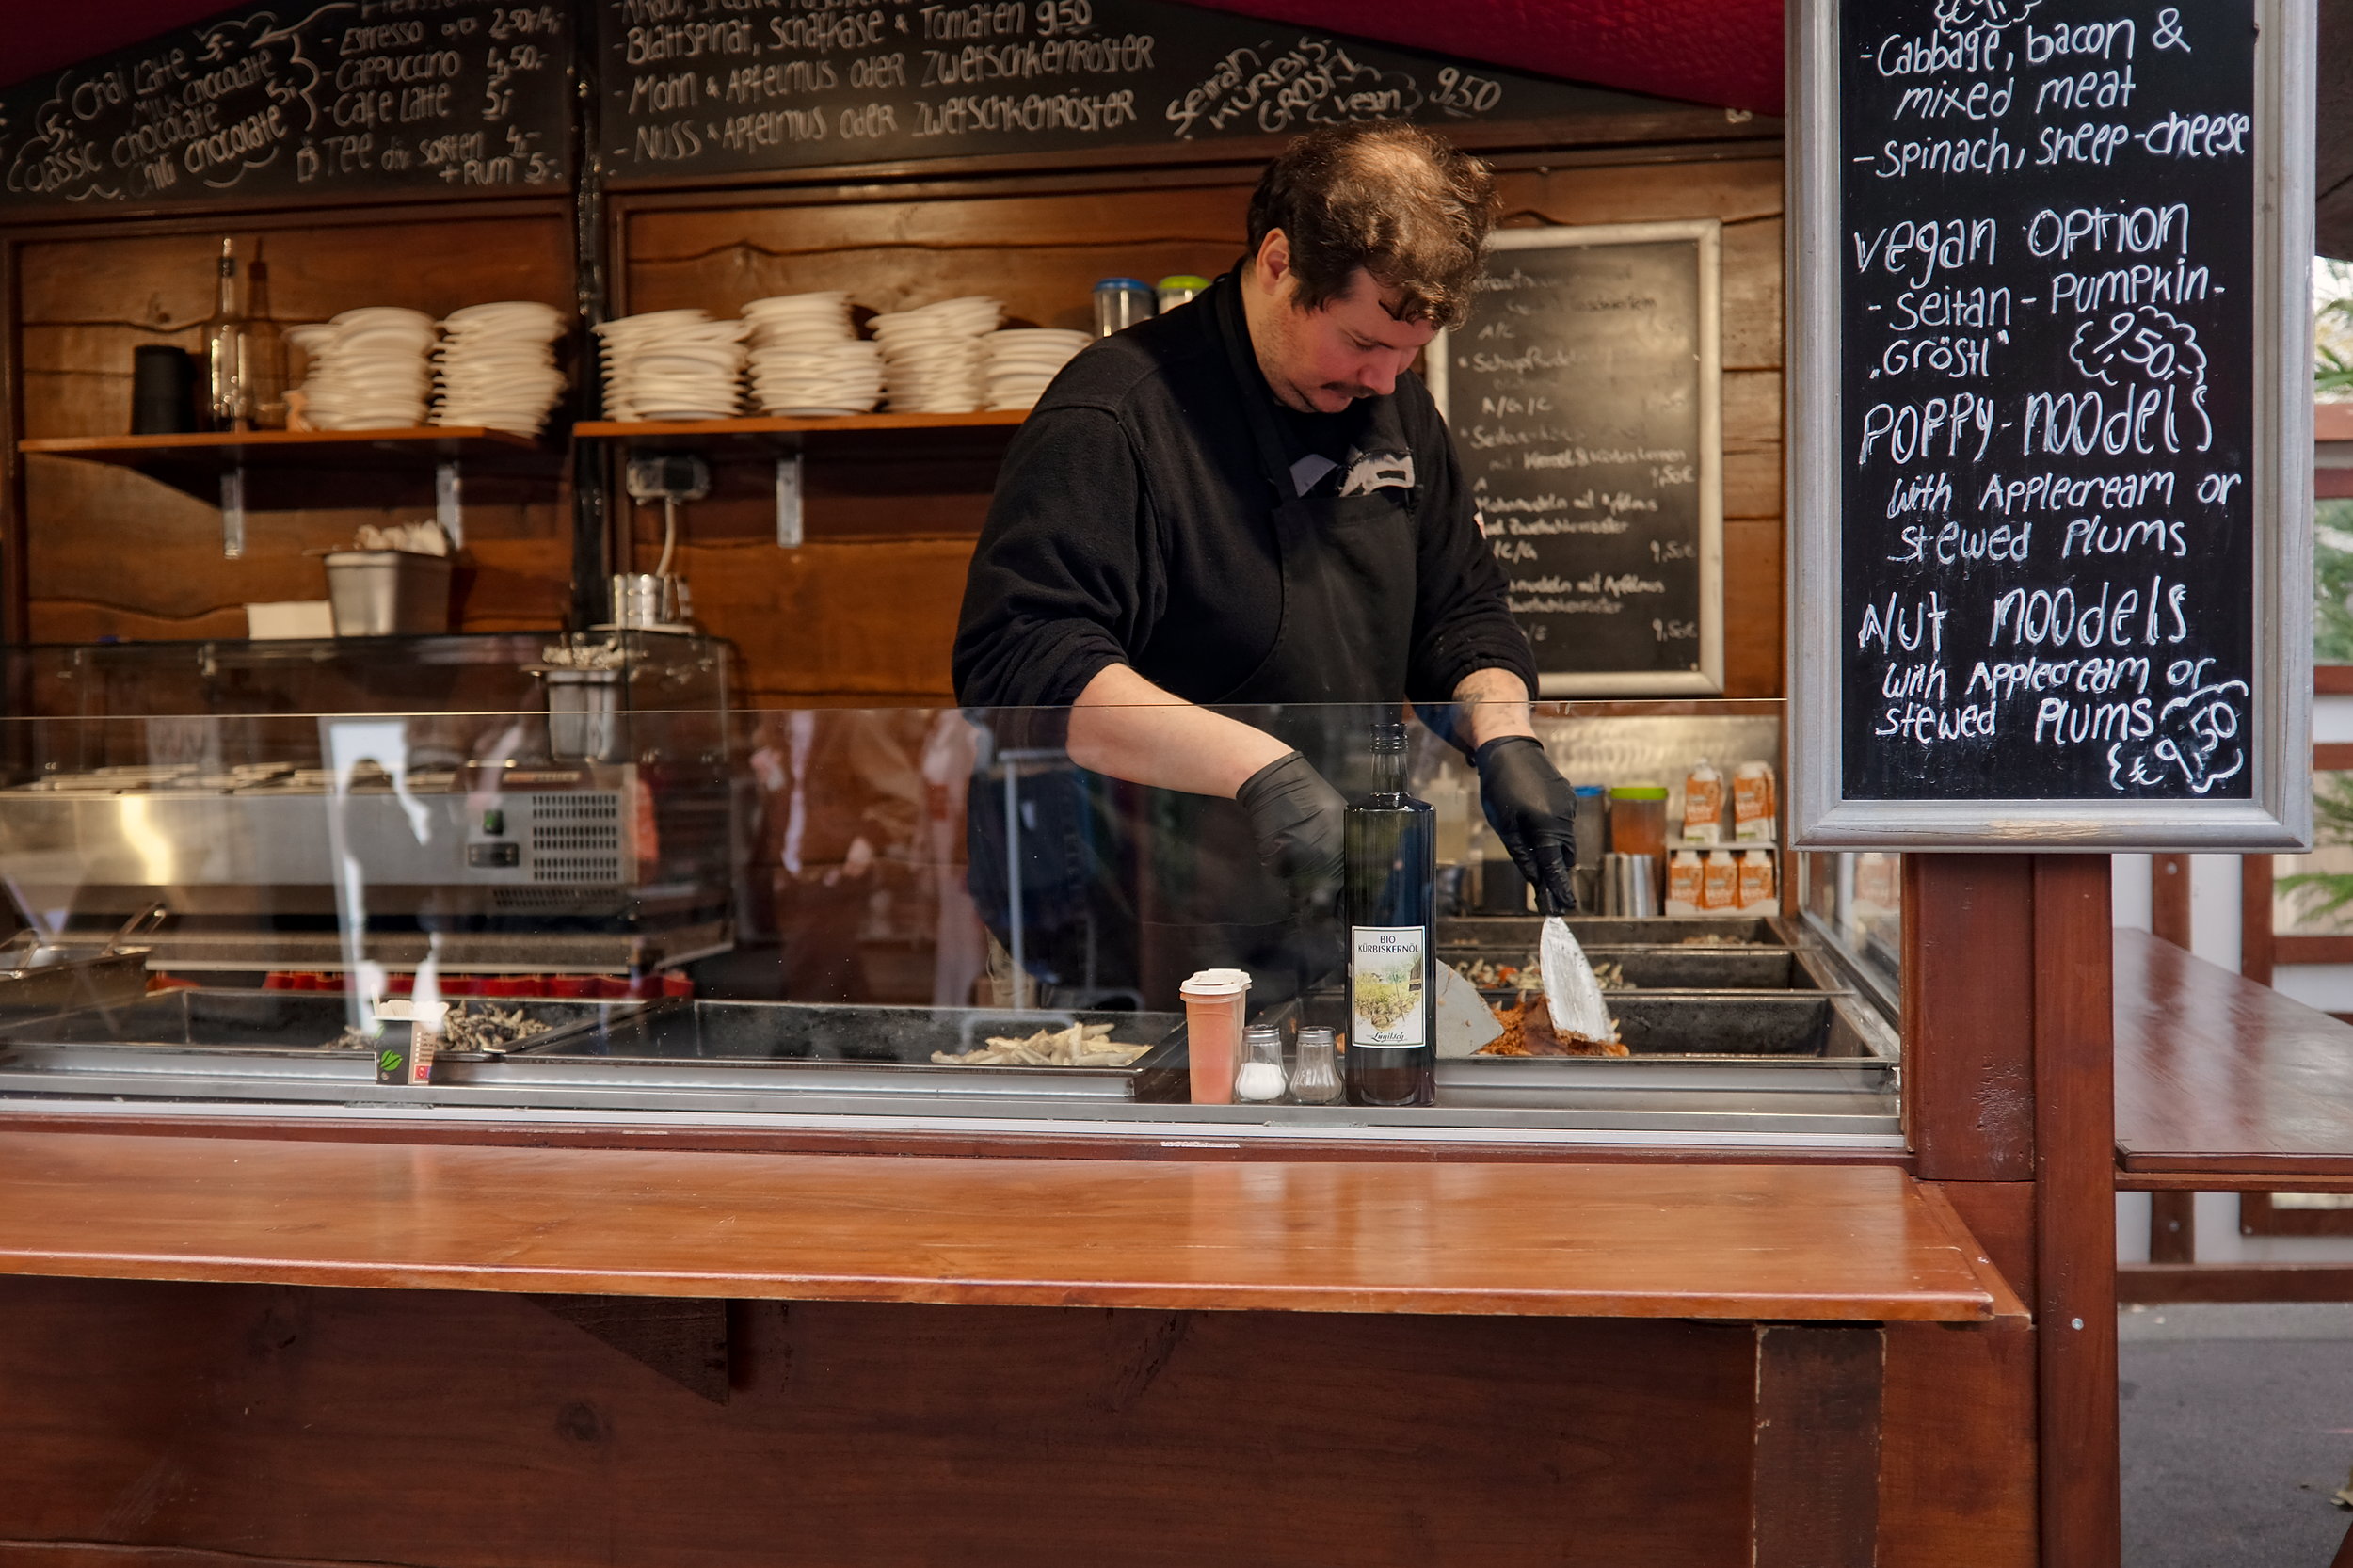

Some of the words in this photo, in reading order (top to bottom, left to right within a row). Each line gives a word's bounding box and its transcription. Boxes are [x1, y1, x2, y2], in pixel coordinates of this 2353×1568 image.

[2027, 19, 2136, 65] bacon
[2153, 8, 2192, 53] &
[1894, 77, 2014, 120] mixed
[2036, 65, 2137, 114] meat
[1853, 217, 1996, 289] vegan
[1886, 472, 1953, 519] with
[2198, 472, 2243, 505] or
[1858, 590, 1949, 654] Nut
[1882, 658, 1948, 700] with
[2167, 657, 2217, 690] or
[1358, 942, 1419, 953] KÜRBISKERNÖL
[1380, 936, 1397, 944] BIO
